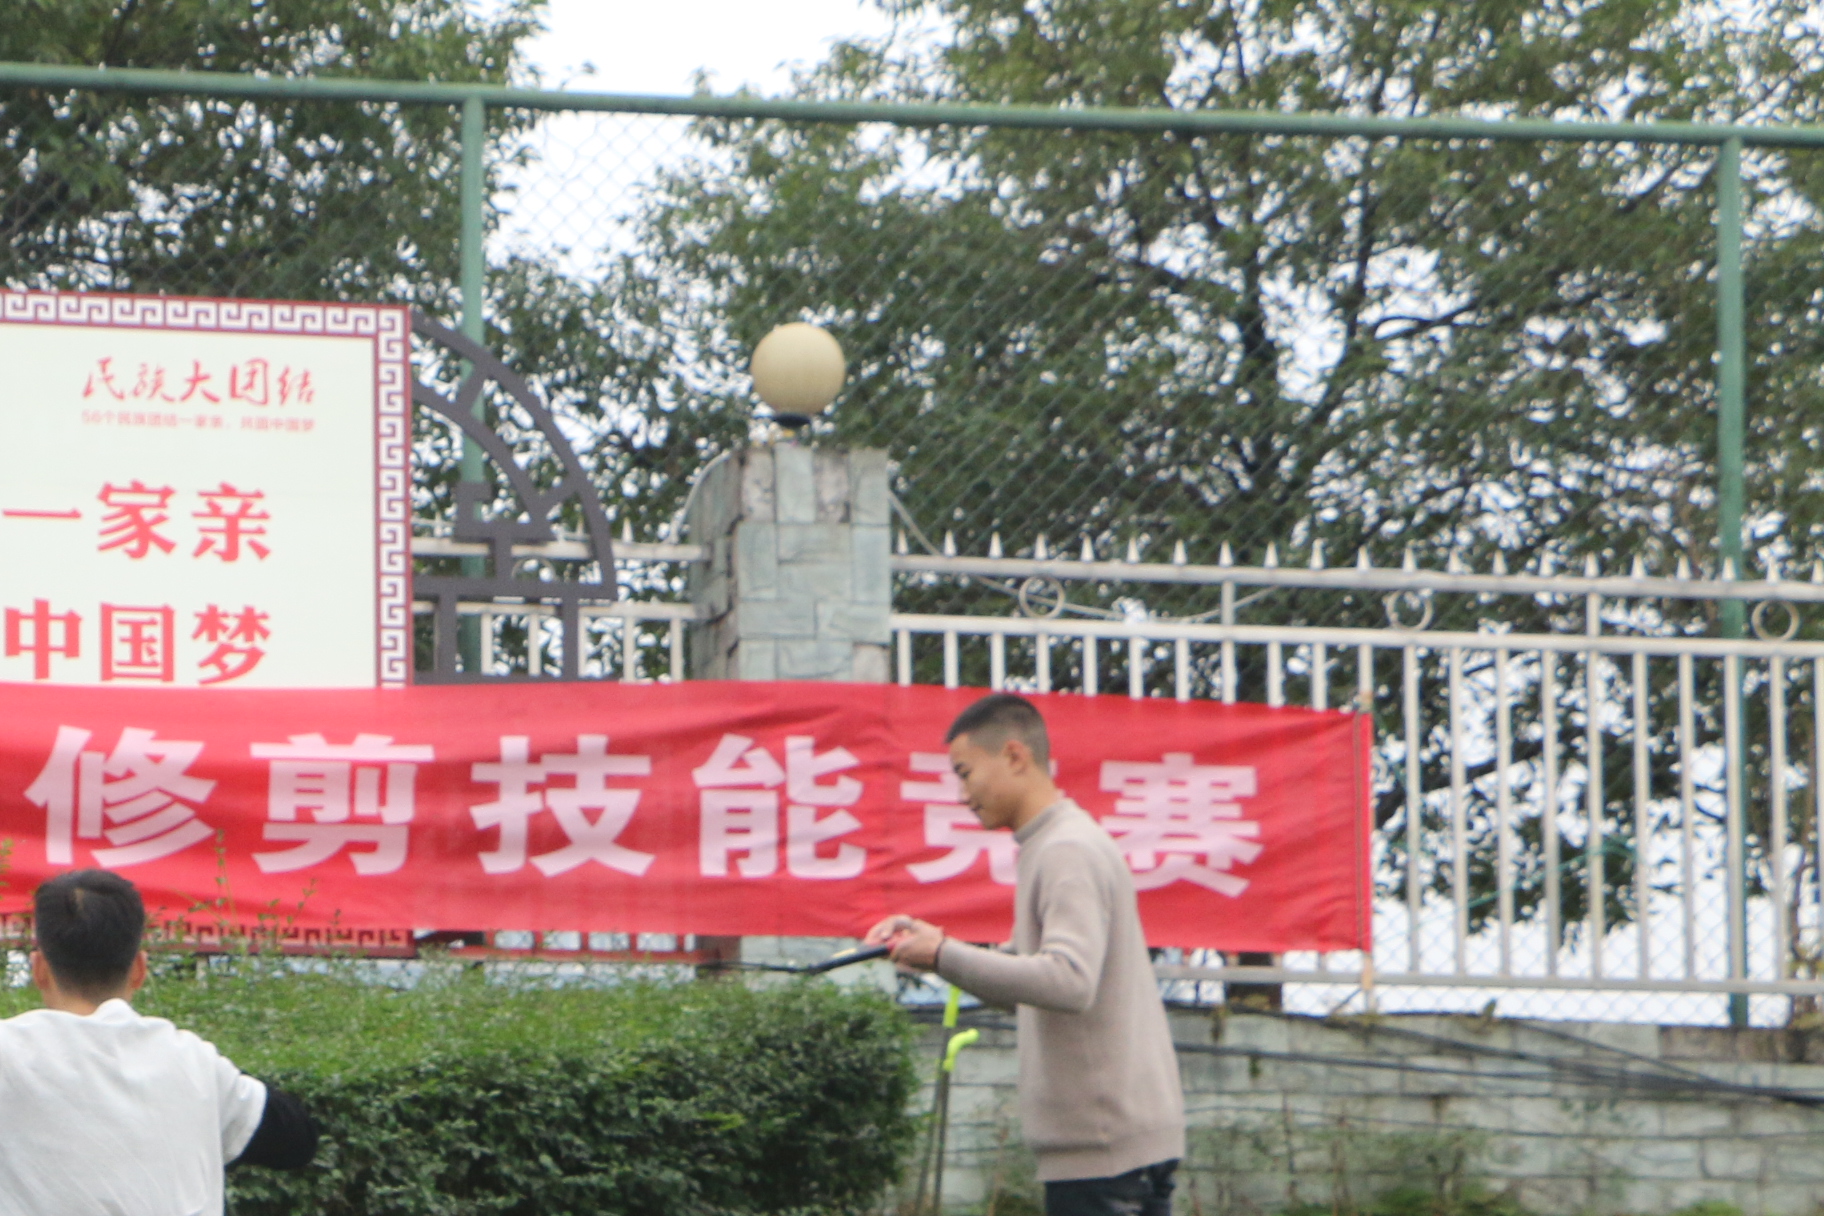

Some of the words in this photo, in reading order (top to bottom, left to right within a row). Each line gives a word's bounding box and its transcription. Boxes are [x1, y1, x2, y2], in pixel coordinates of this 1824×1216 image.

[82, 356, 315, 406] 民族大团结
